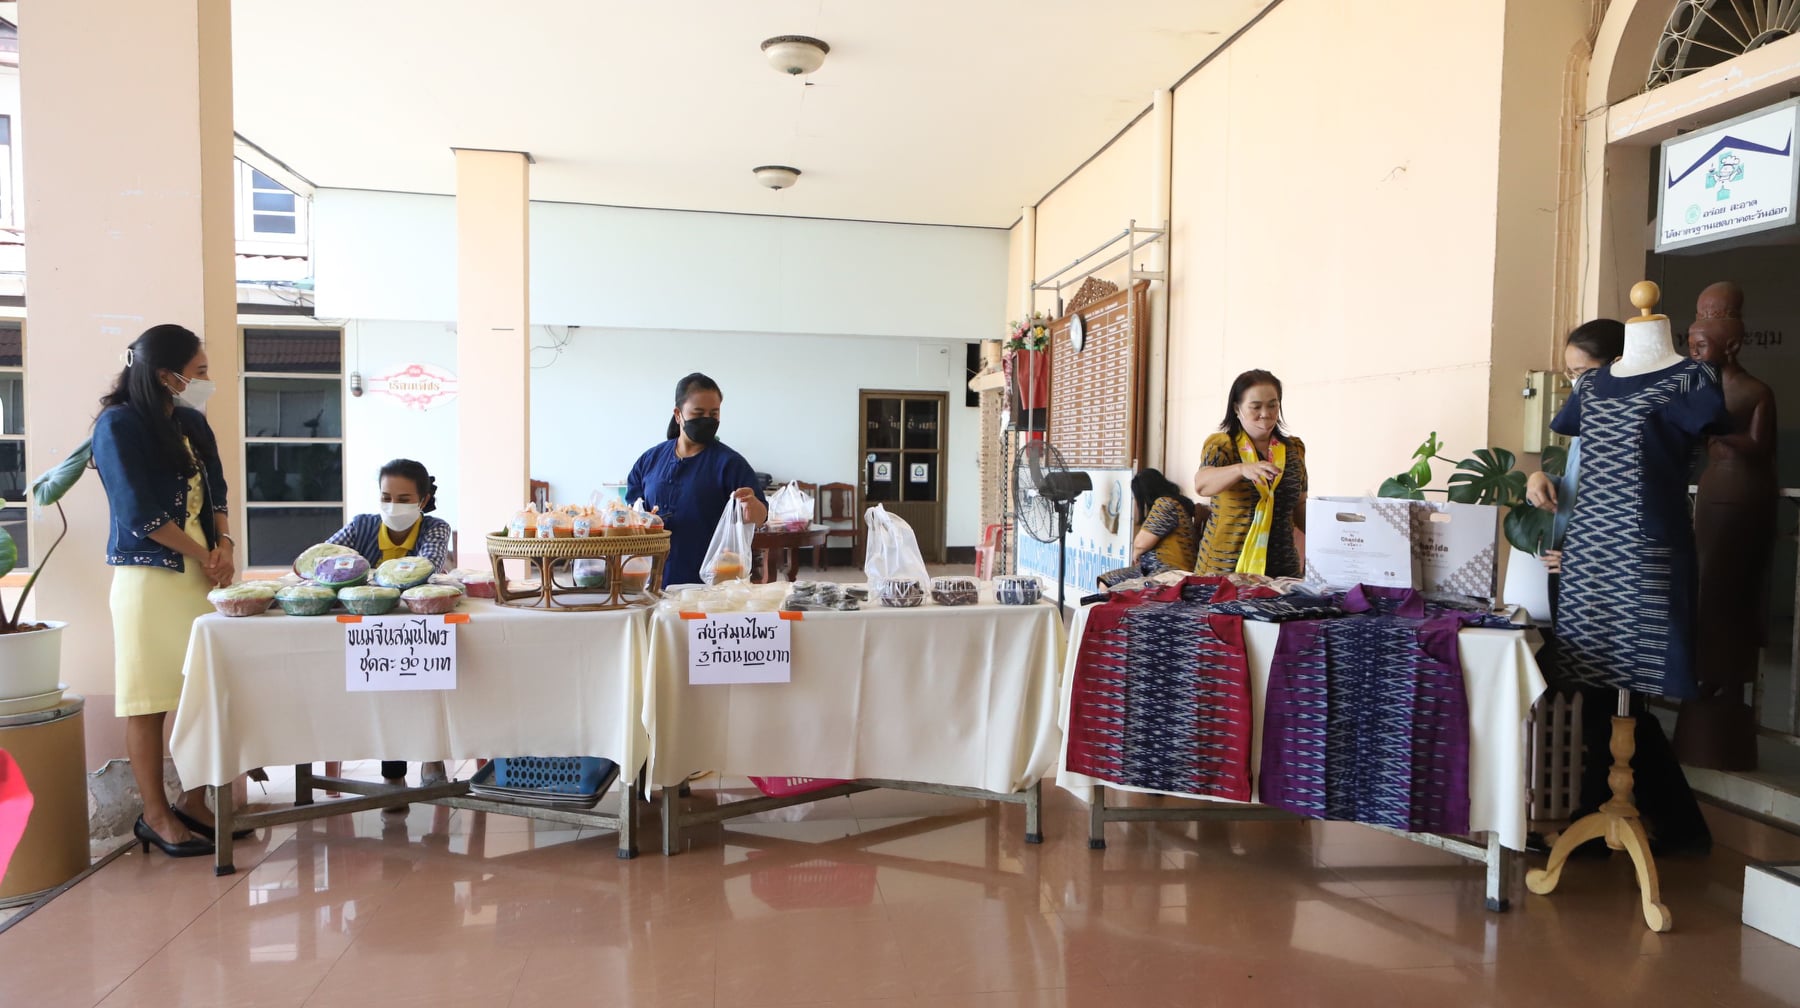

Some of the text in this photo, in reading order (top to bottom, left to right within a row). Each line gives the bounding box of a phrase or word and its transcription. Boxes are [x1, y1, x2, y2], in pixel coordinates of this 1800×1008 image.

[1702, 206, 1727, 218] อร่อย
[1730, 199, 1758, 212] สะอาด
[348, 619, 450, 656] ขนมจีนสมุนไพร
[696, 617, 778, 645] สบู่สมุนไพร
[360, 648, 396, 682] ชุดละ
[423, 656, 451, 672] บาท
